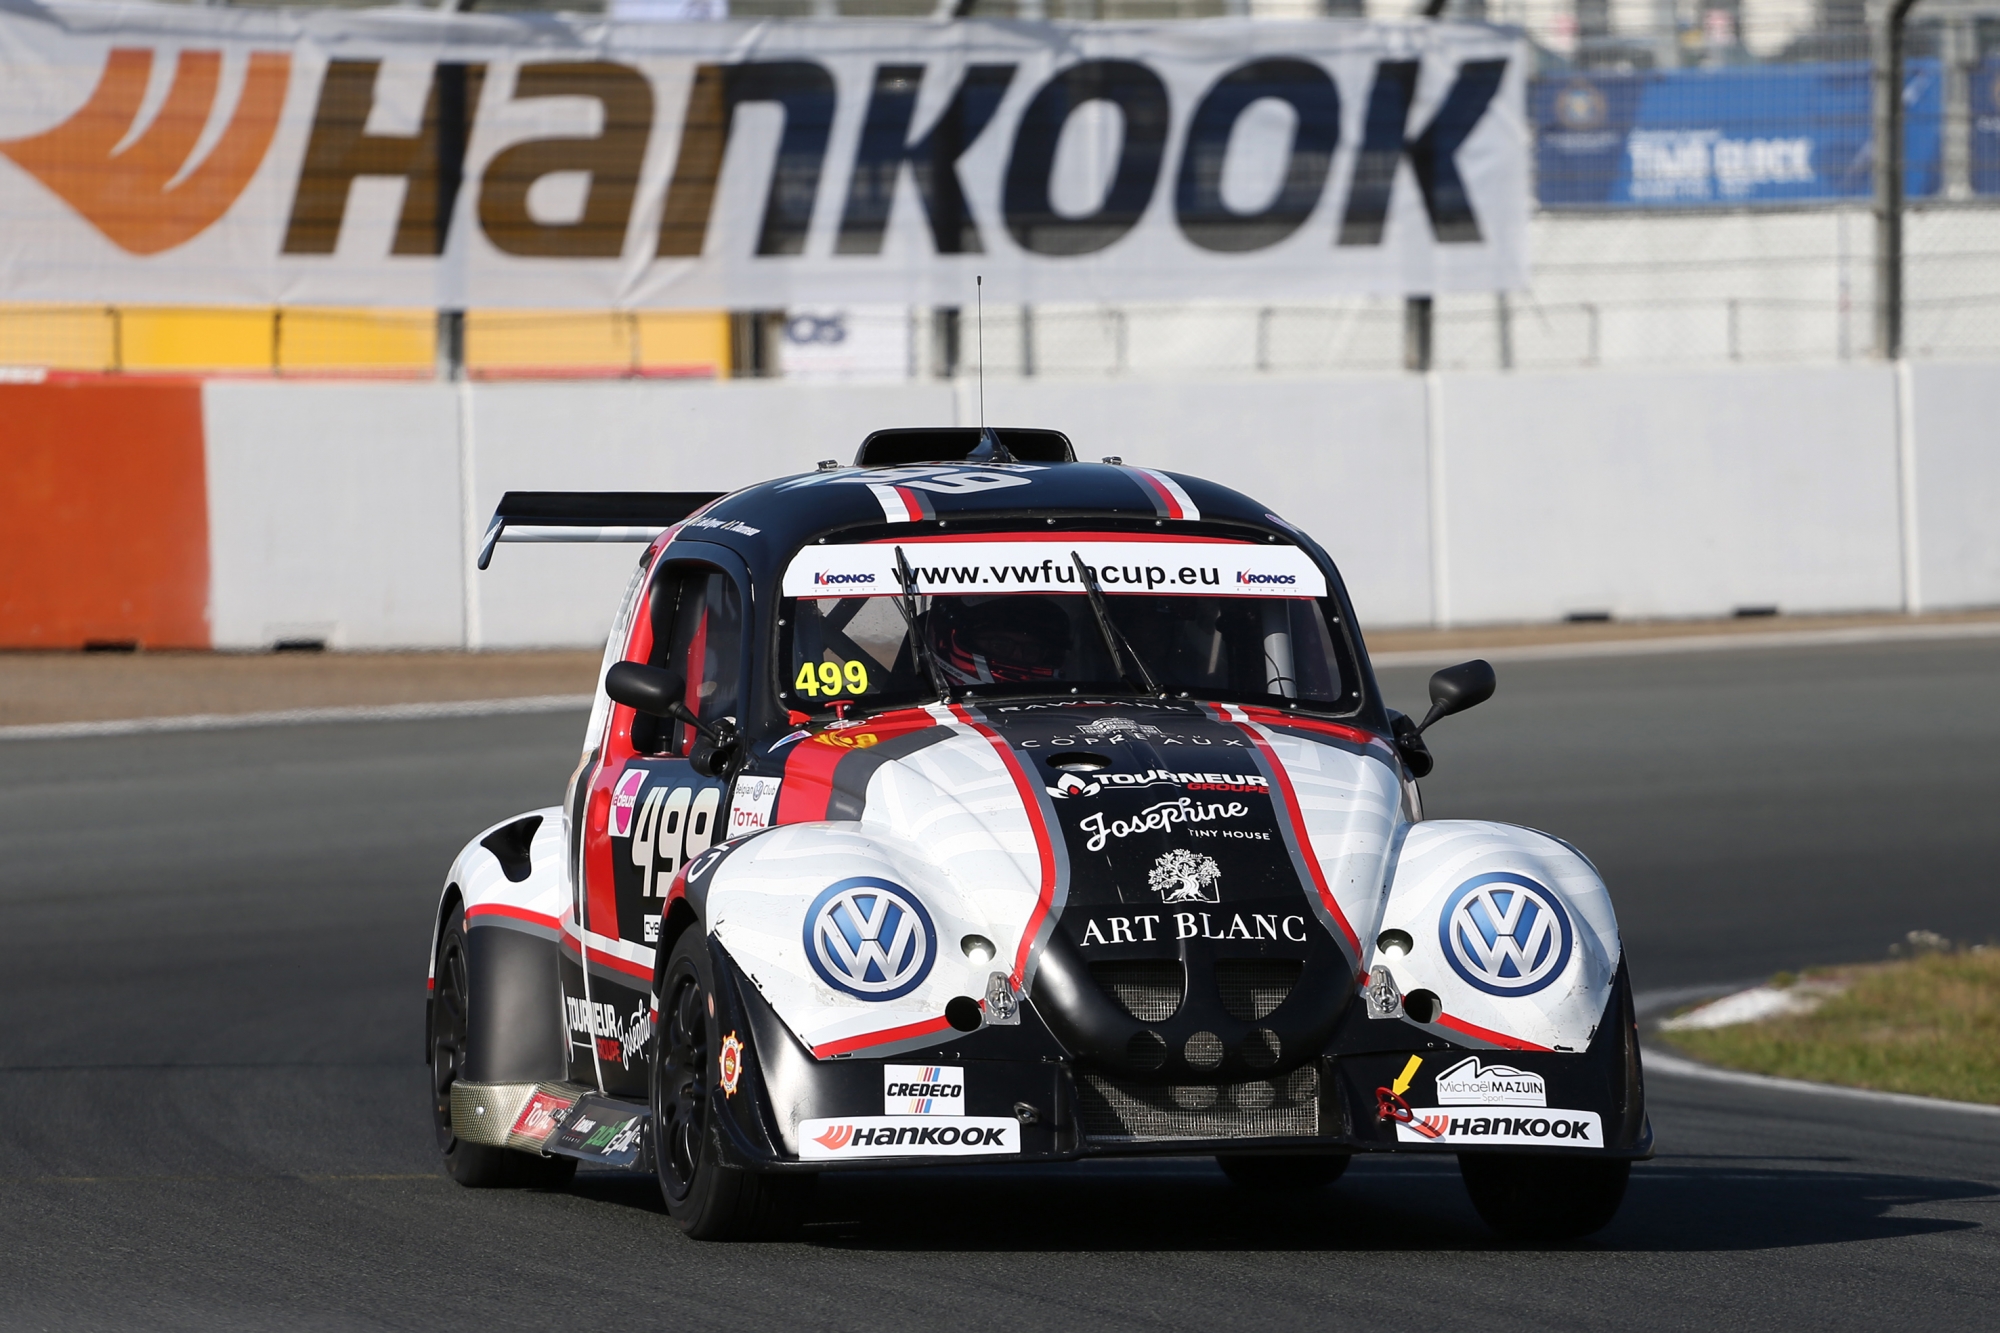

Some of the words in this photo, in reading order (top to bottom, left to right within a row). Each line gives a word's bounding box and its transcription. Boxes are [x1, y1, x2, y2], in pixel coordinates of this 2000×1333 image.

[814, 569, 875, 586] KRONOS
[891, 559, 1220, 590] www.vwfuncup.eu
[1236, 568, 1296, 584] KRONOS
[795, 660, 869, 697] 499
[1093, 769, 1270, 786] TOURNEUR
[1187, 782, 1271, 795] GROUPE
[733, 807, 765, 827] TOTAL
[1079, 797, 1249, 851] Josephine
[632, 786, 721, 898] 499
[1187, 828, 1218, 838] TINY
[1223, 830, 1271, 841] HOUSE
[1080, 915, 1160, 947] ART
[1173, 912, 1308, 942] BLANC
[596, 1037, 622, 1063] ROUPE
[887, 1082, 962, 1098] CREDECO
[1439, 1080, 1491, 1093] Michaël
[1491, 1081, 1543, 1094] MAZUIN
[1481, 1094, 1505, 1103] Sport
